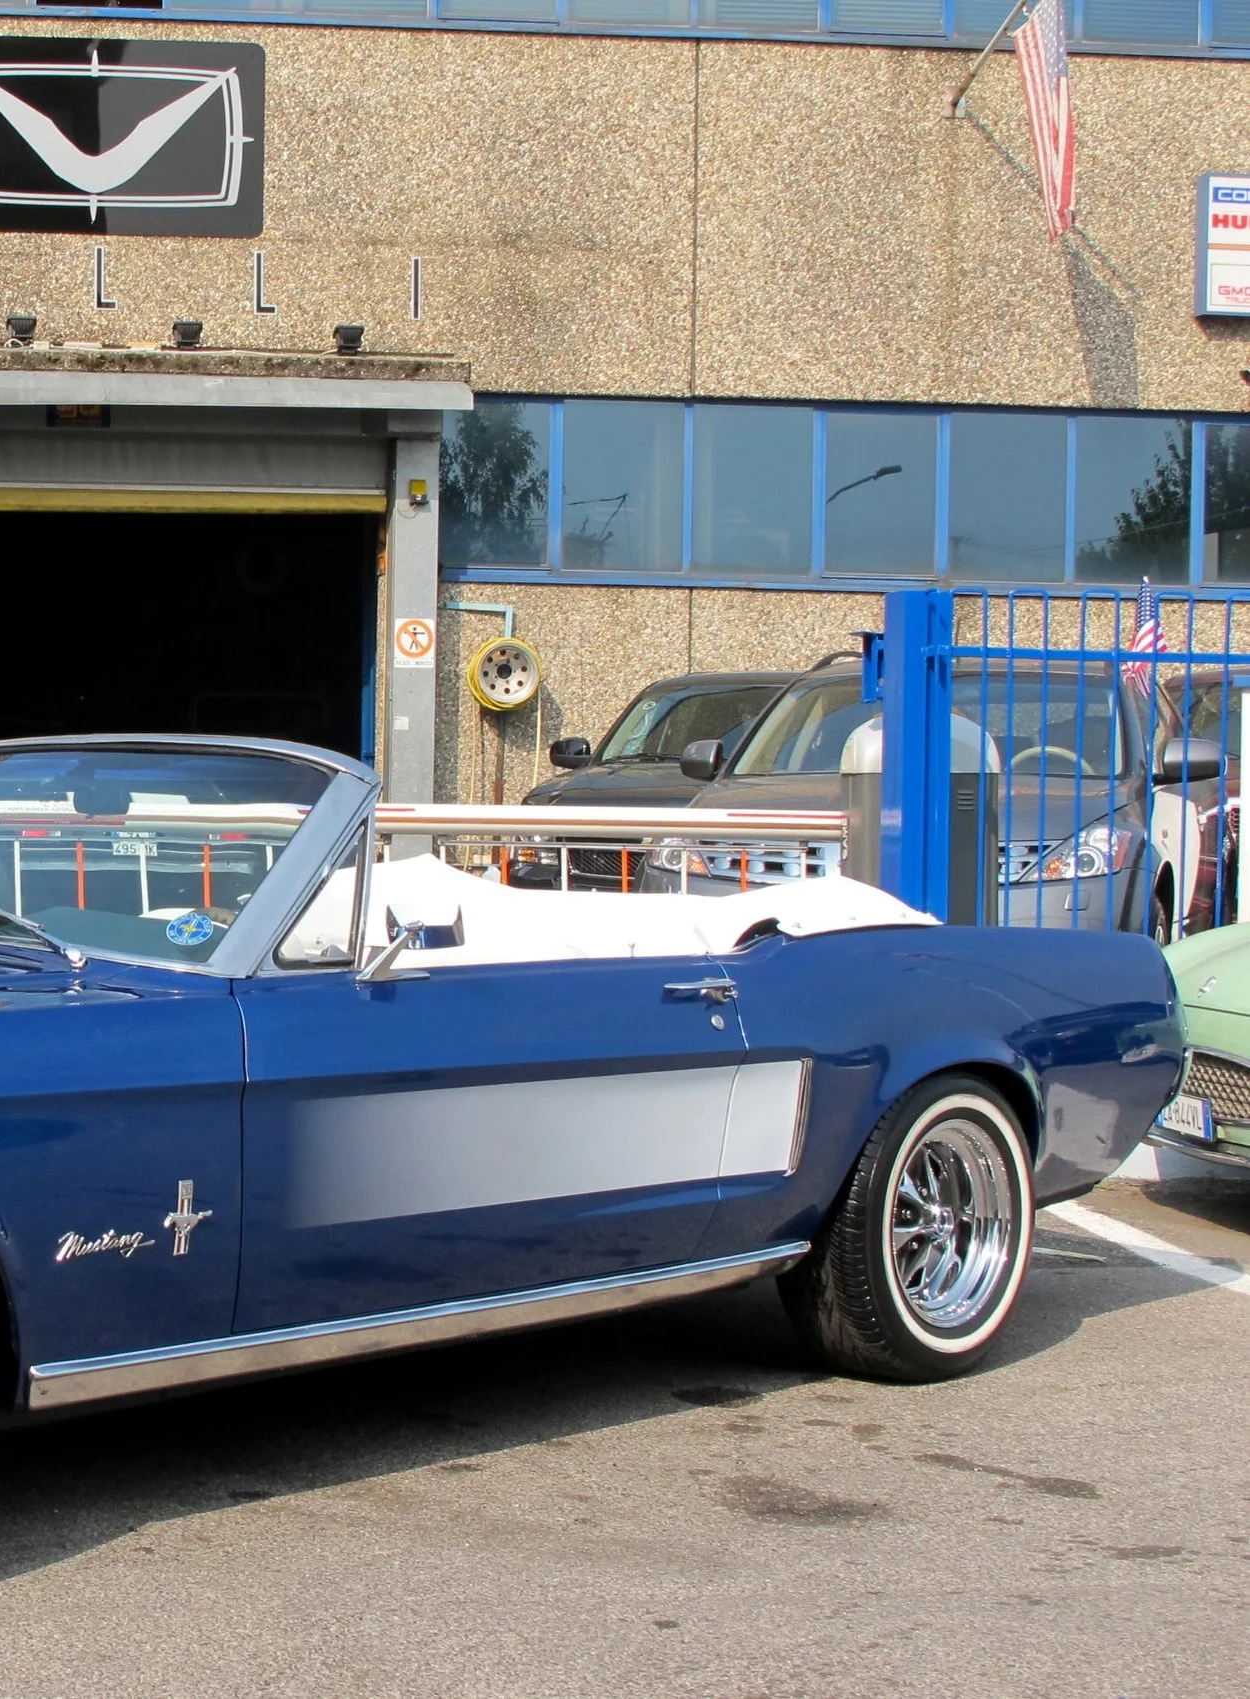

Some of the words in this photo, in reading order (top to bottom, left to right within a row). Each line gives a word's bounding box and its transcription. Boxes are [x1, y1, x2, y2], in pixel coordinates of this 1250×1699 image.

[1217, 189, 1250, 202] CO
[1212, 213, 1250, 229] HU
[56, 1229, 155, 1261] Mustang
